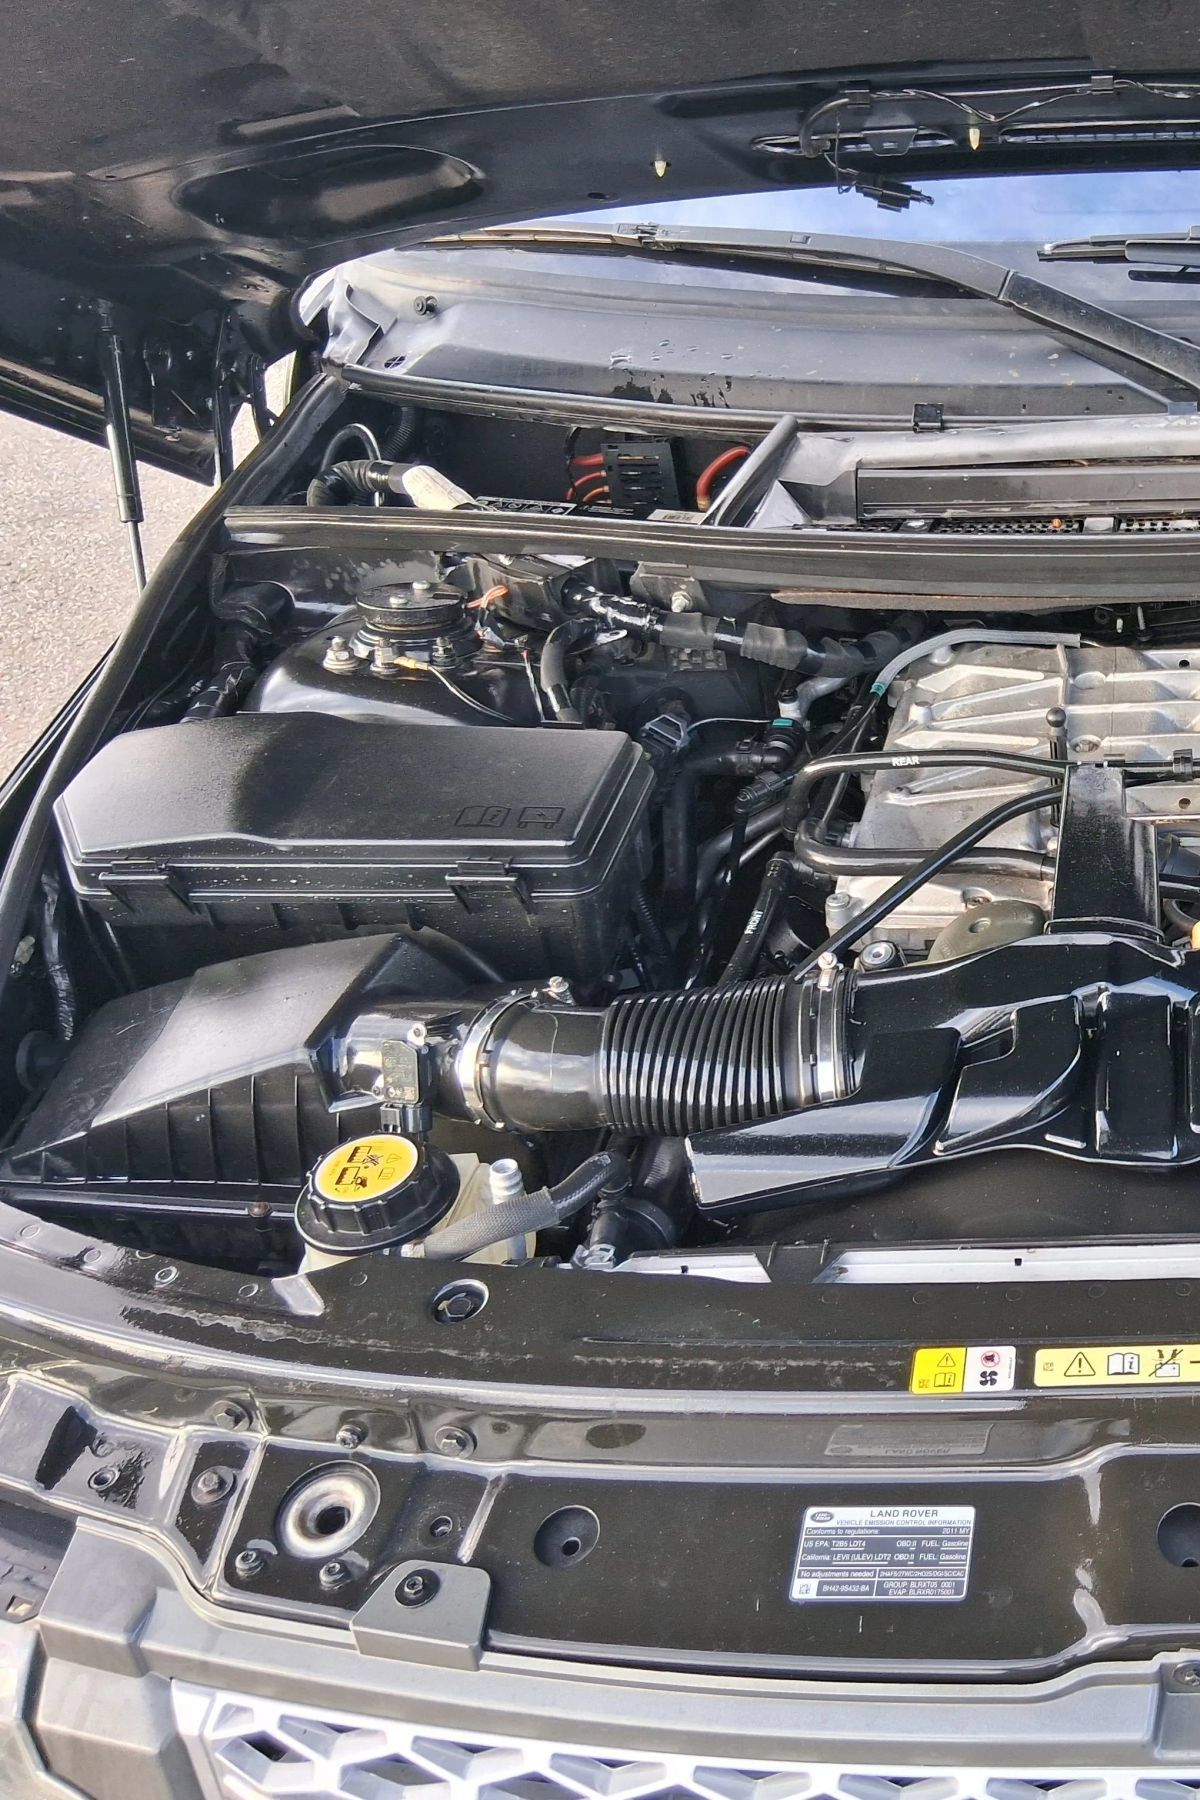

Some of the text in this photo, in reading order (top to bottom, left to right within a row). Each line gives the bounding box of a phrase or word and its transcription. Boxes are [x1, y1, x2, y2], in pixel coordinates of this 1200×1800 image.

[892, 756, 920, 766] REAR
[744, 910, 763, 934] FRONT
[870, 1510, 938, 1518] LAND ROVER
[812, 1570, 849, 1578] adjustments
